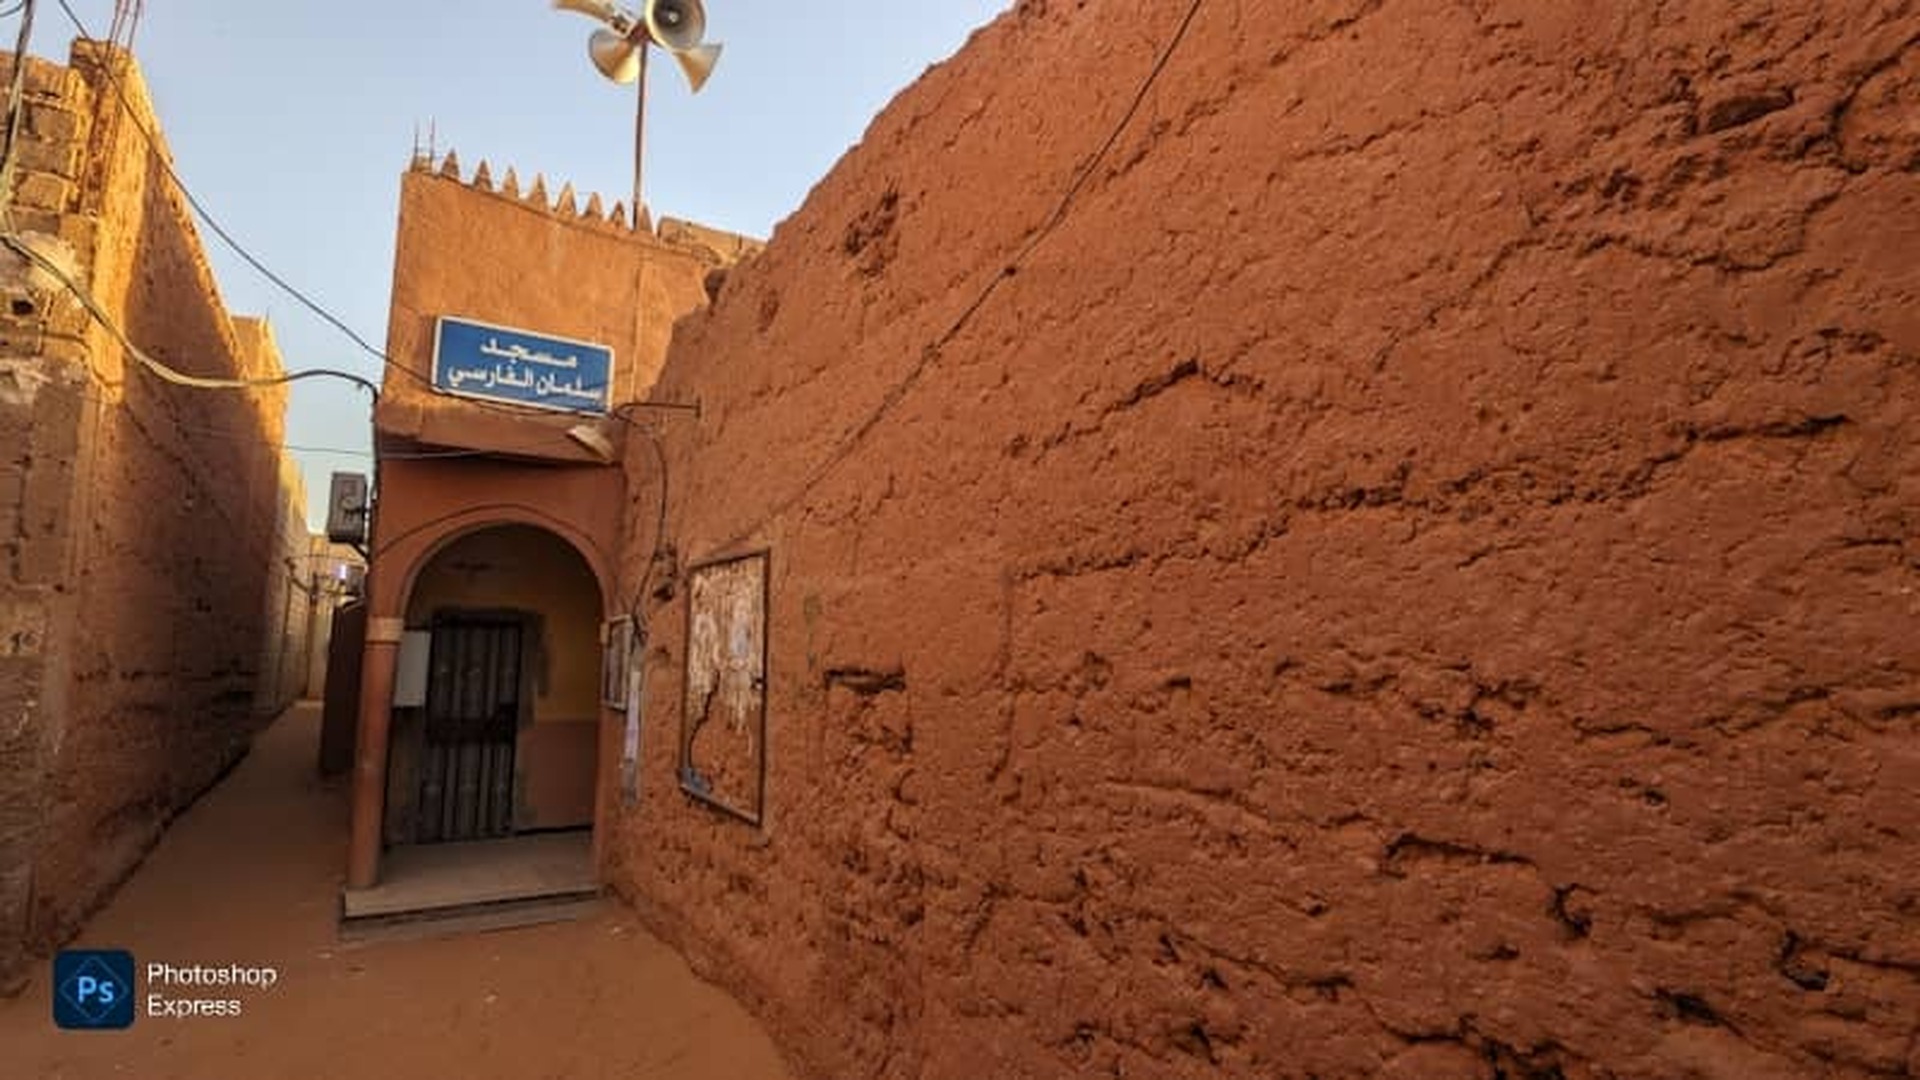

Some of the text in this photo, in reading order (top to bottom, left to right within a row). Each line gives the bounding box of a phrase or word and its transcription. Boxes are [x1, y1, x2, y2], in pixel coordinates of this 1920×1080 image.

[480, 338, 577, 368] مسجد
[448, 364, 602, 400] سلمان الفارسي
